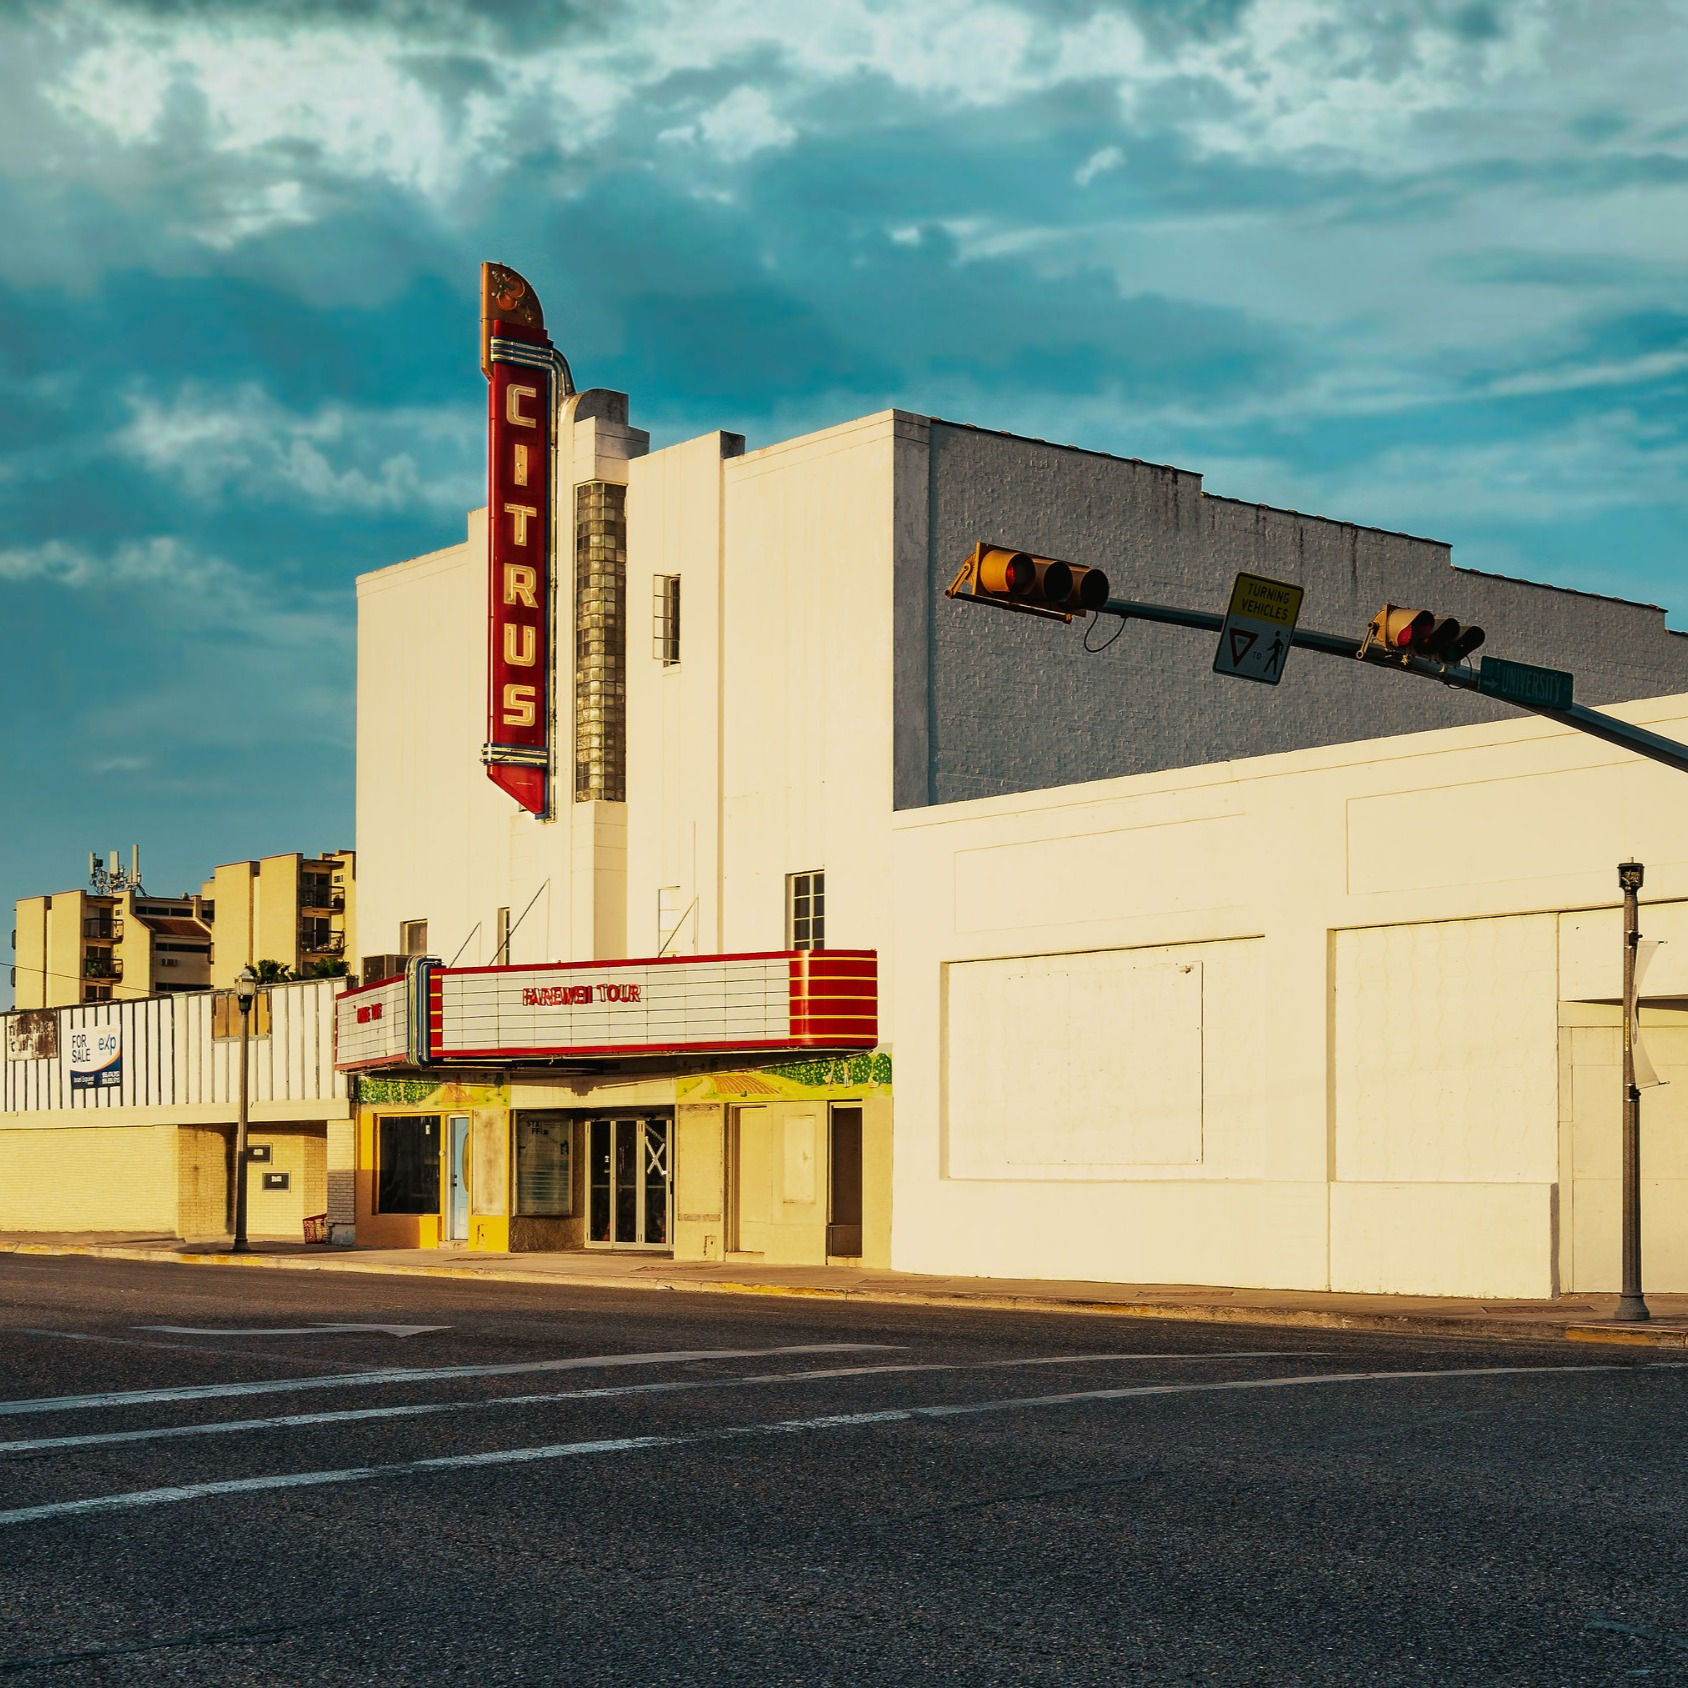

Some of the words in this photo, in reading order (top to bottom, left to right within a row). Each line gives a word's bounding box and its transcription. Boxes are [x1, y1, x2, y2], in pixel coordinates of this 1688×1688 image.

[502, 383, 539, 728] CITRUS
[1248, 583, 1291, 604] TURNING
[1241, 598, 1289, 620] VEHICLES
[1502, 666, 1561, 704] UNIVERSITY
[596, 983, 641, 1003] TOUR
[72, 1034, 87, 1049] FOR
[72, 1048, 91, 1063] SALE
